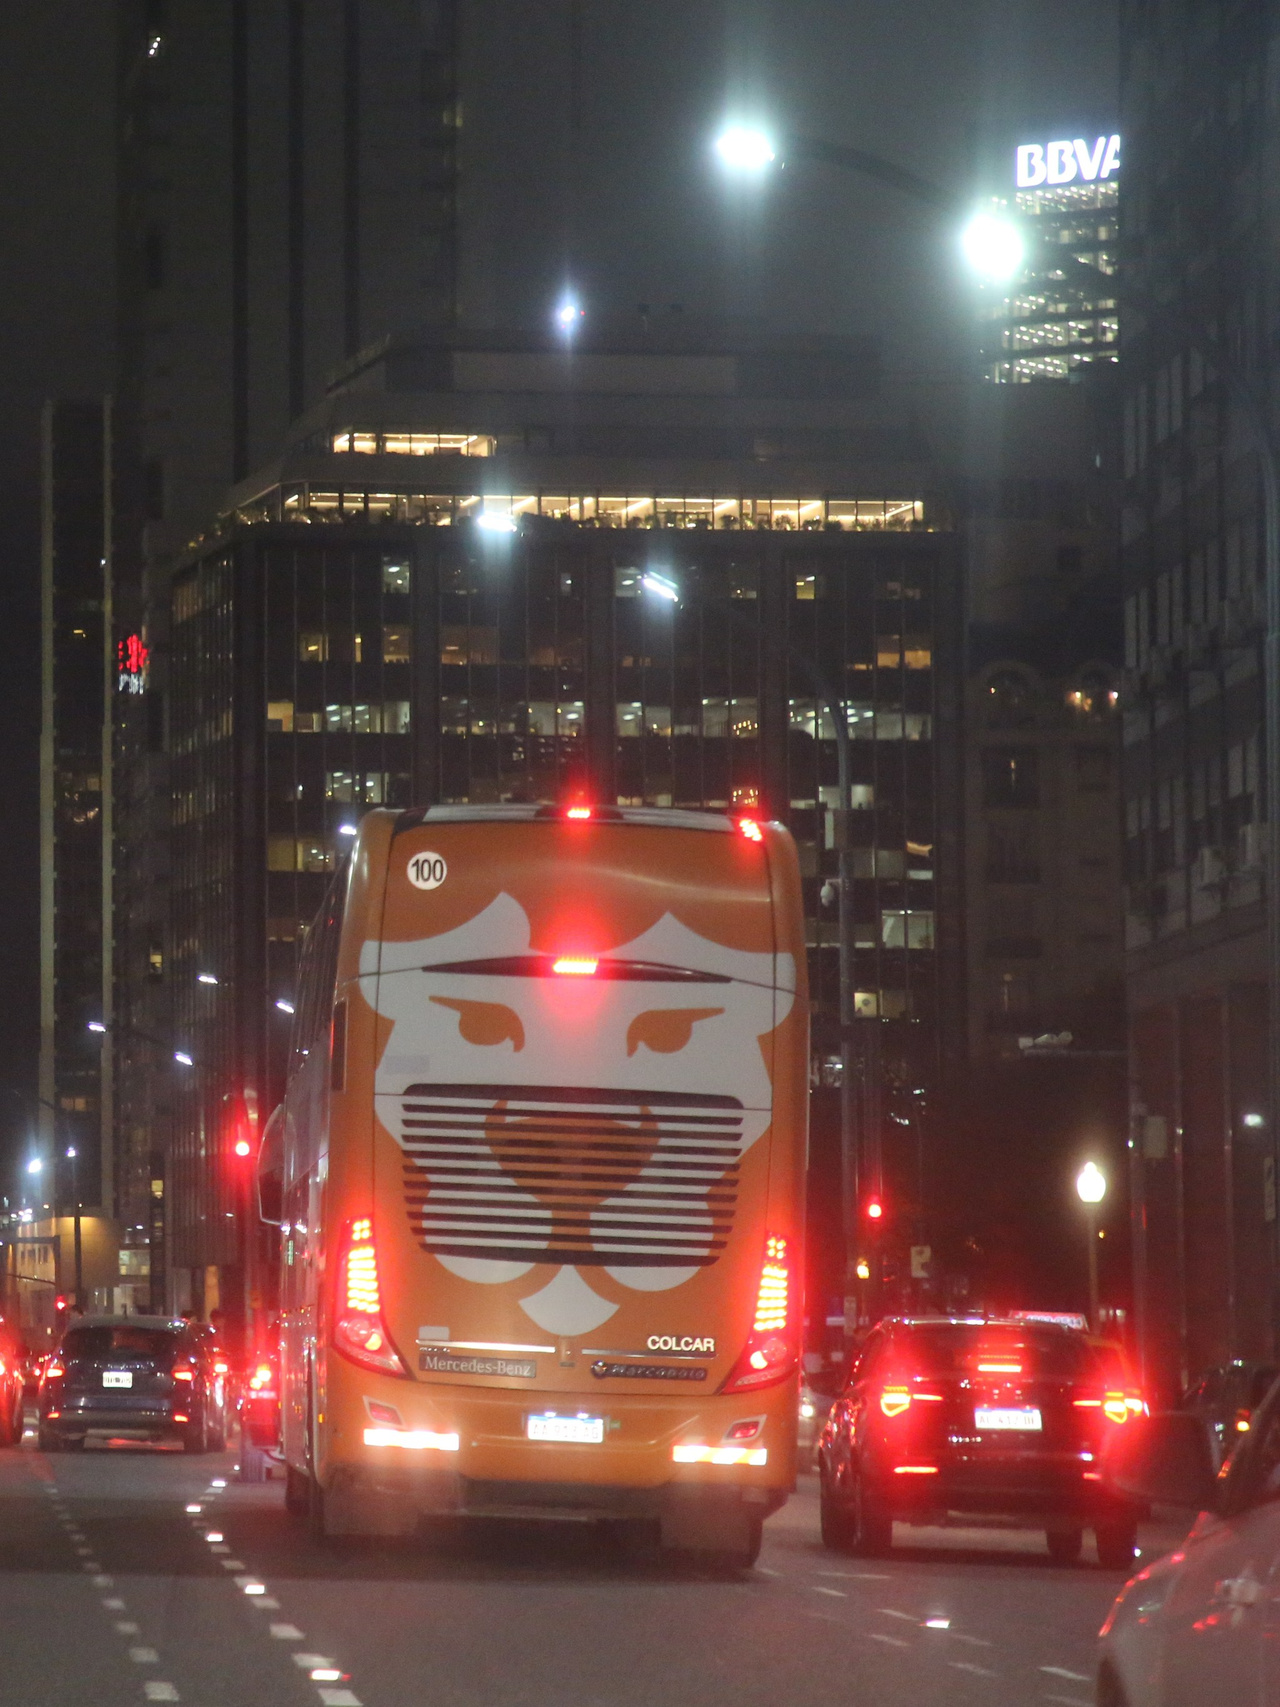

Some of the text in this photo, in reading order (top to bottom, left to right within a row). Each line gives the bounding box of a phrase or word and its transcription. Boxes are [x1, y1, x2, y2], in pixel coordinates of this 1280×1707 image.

[1017, 135, 1120, 187] BBVA
[411, 859, 444, 882] 100
[647, 1336, 715, 1352] COLCAR
[425, 1356, 532, 1376] Mercedes-Benz
